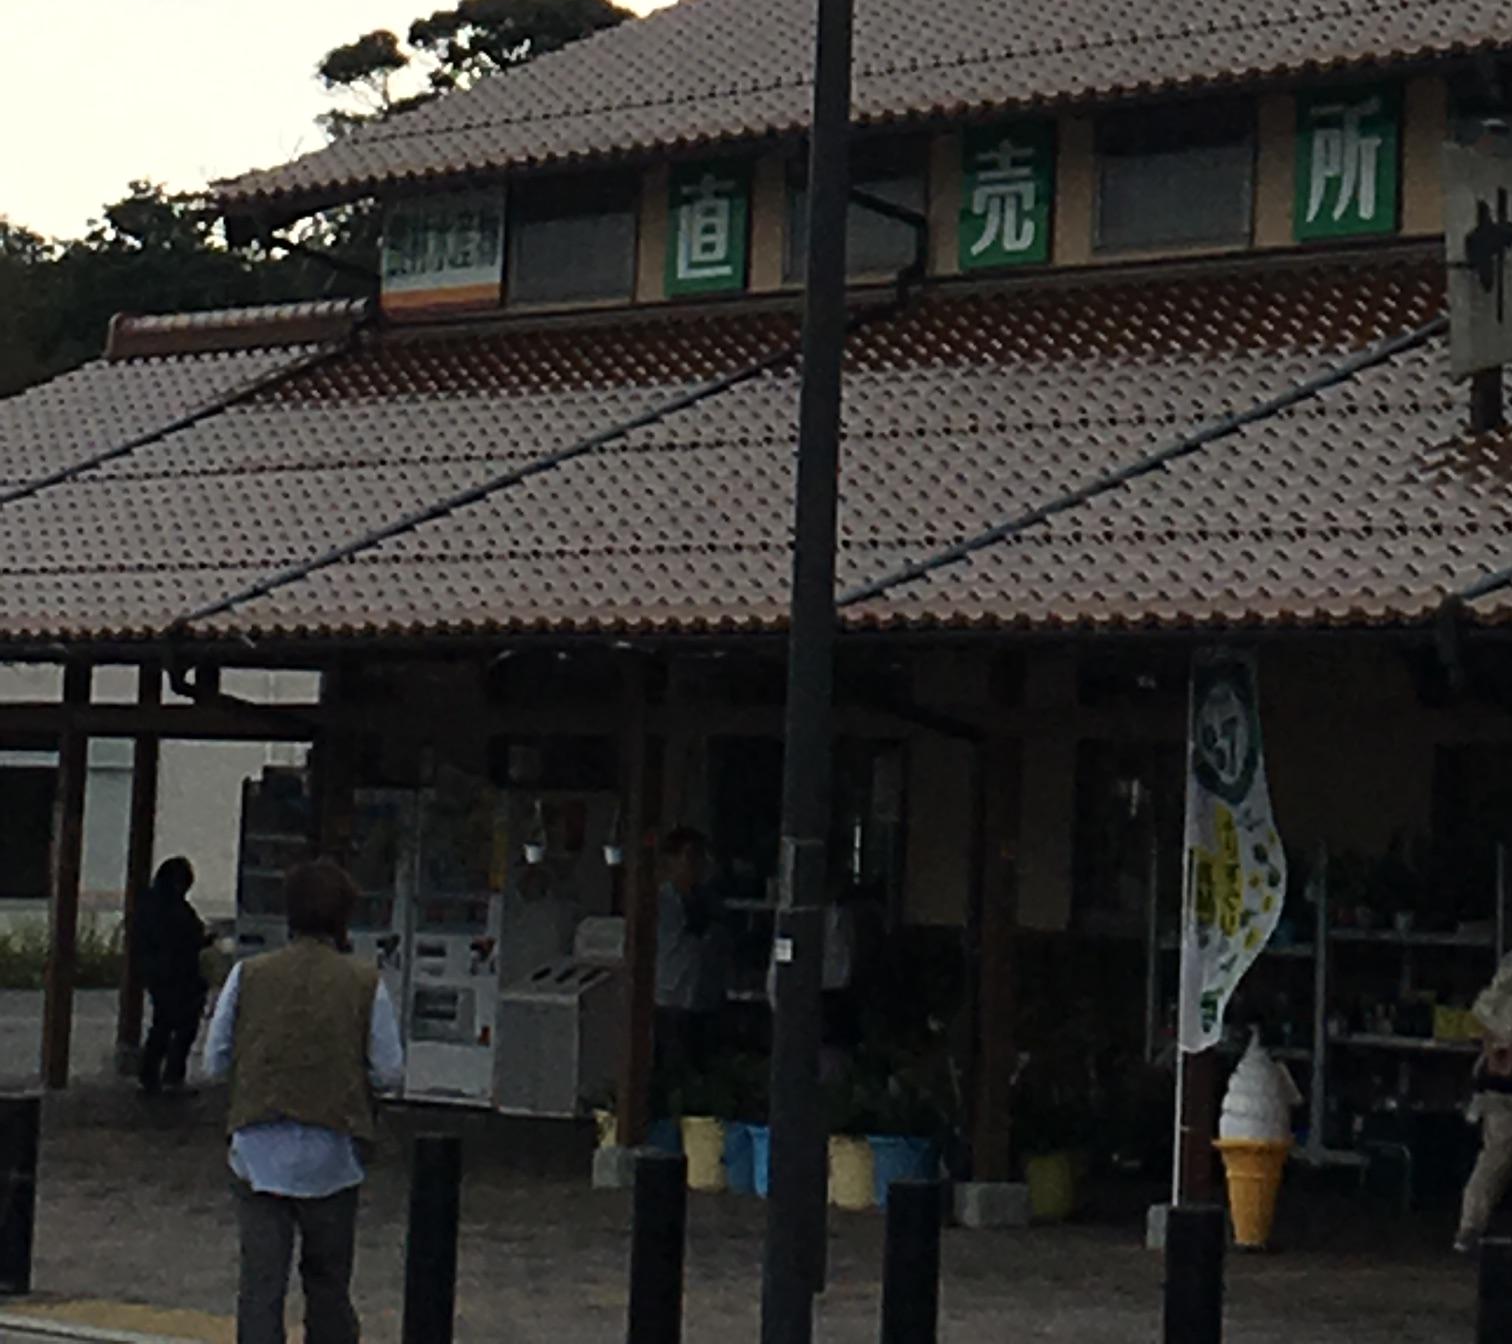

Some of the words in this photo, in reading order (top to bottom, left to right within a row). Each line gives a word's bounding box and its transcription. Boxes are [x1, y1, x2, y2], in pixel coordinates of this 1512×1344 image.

[677, 173, 737, 280] 直
[970, 139, 1035, 255] 売
[1306, 95, 1382, 223] 所
